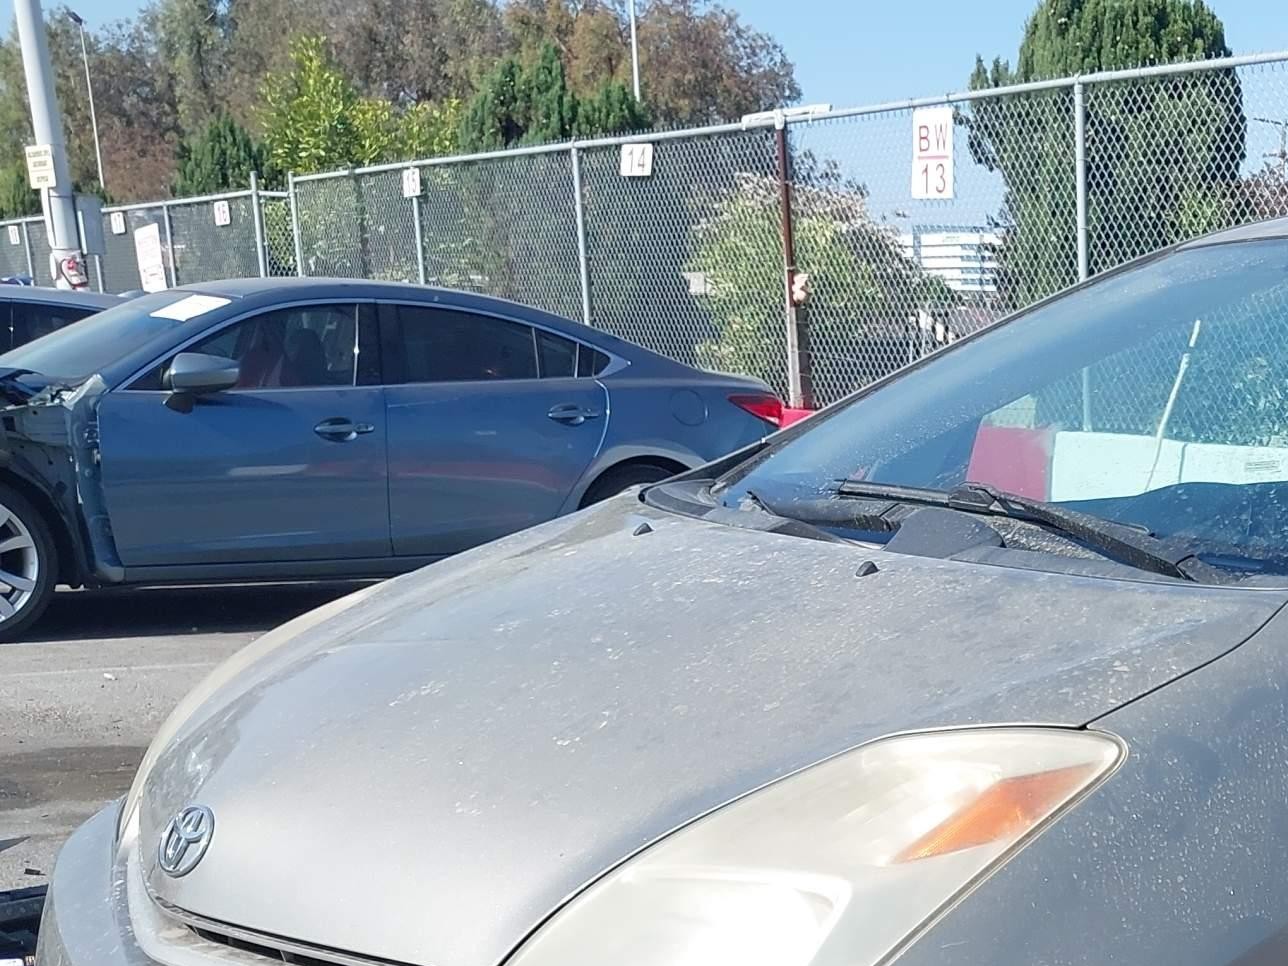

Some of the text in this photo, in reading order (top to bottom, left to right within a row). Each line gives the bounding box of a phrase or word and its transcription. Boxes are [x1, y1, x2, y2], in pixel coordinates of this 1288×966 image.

[918, 122, 948, 152] BW
[628, 146, 646, 174] 14
[921, 163, 946, 194] 13
